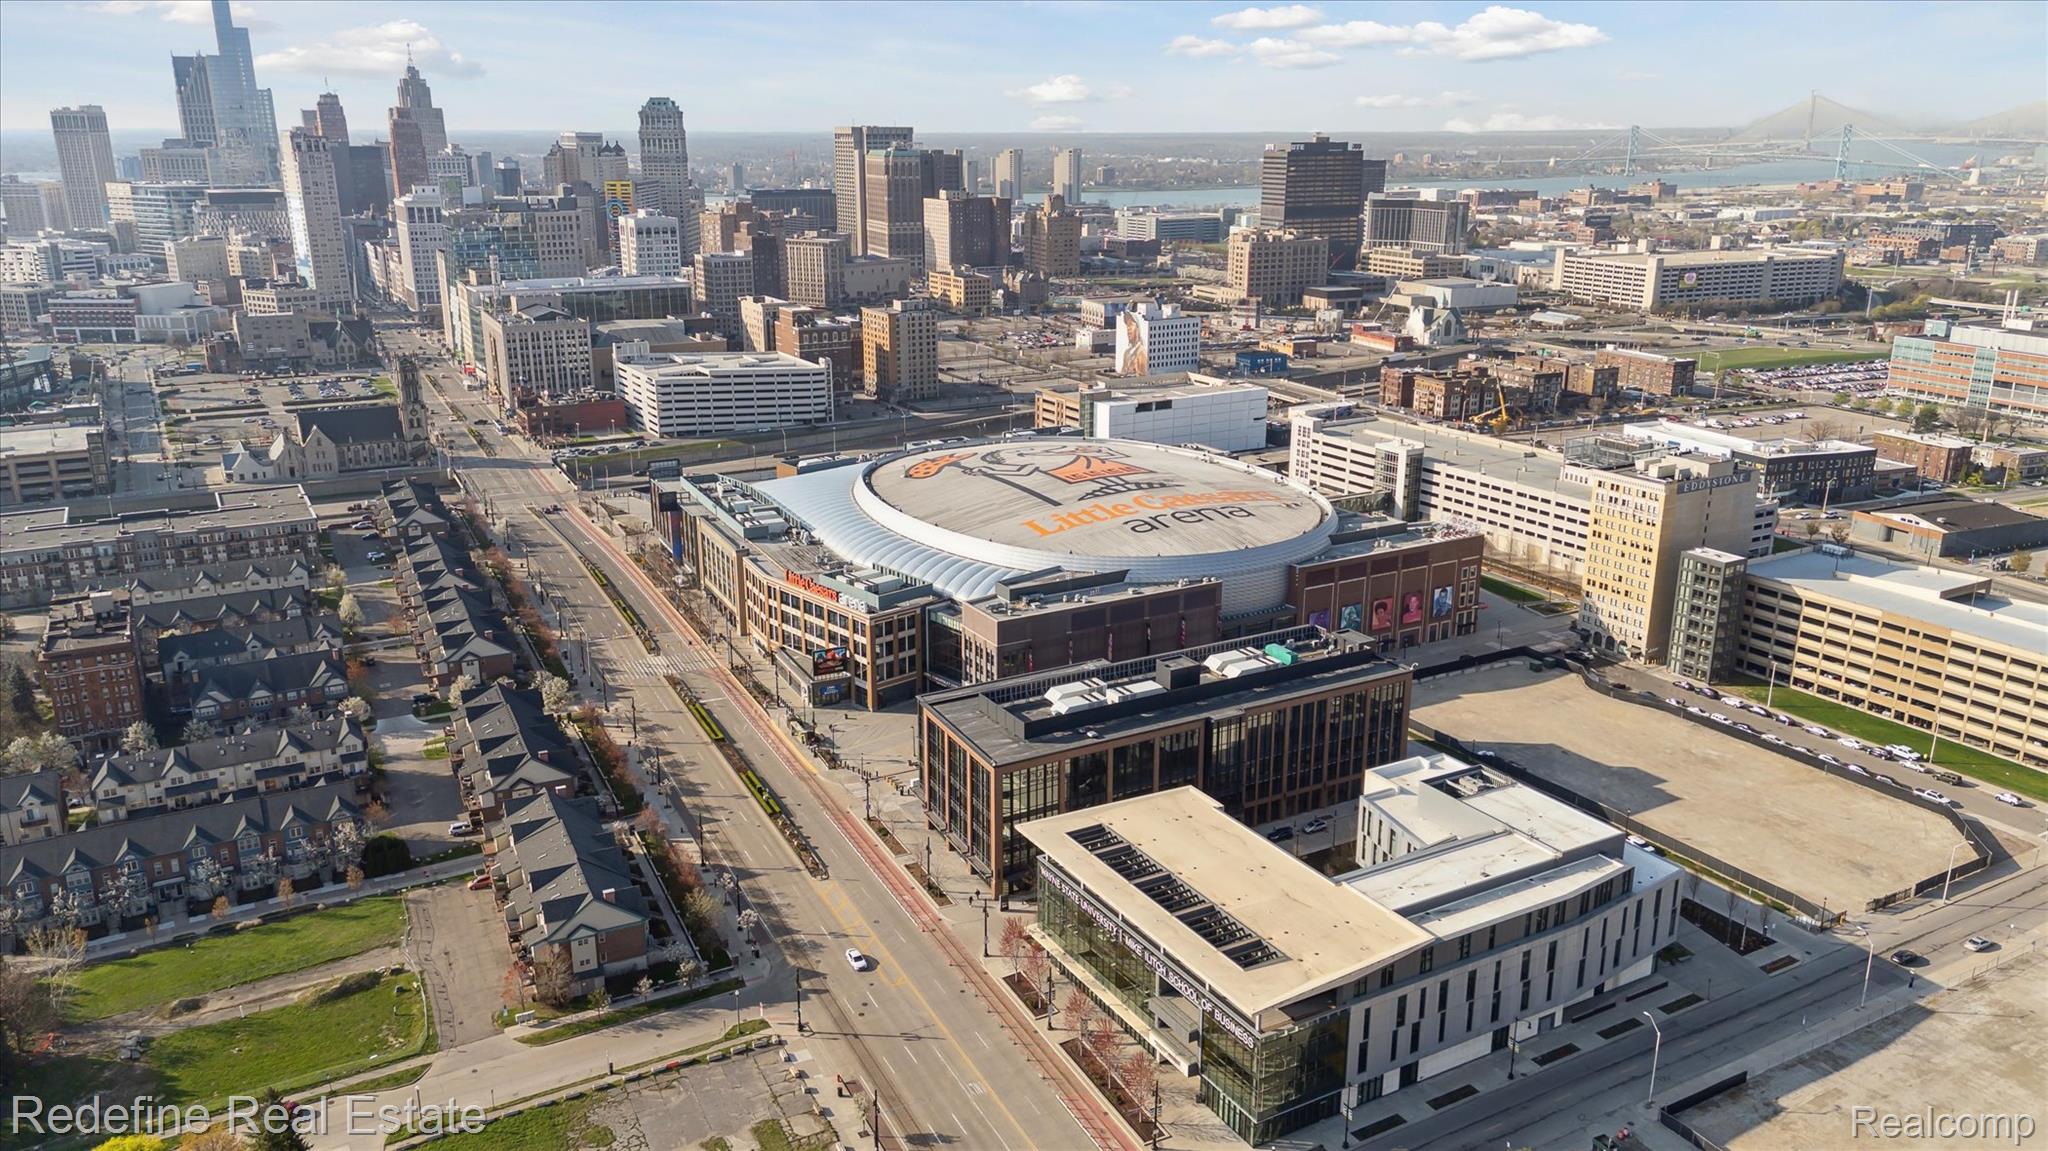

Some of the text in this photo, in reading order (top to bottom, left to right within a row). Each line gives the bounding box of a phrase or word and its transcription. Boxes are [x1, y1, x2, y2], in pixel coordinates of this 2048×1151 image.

[1683, 474, 1745, 492] EDDYSTONE
[1020, 498, 1139, 537] Little
[1123, 505, 1256, 533] arena
[1040, 865, 1061, 888] WAYNE
[1061, 884, 1080, 905] STATE
[1080, 899, 1118, 936] UNIVERSITY
[1125, 935, 1144, 957] MIKE
[1168, 972, 1199, 1004] SCHOOL
[1200, 998, 1213, 1013] OF
[1214, 1009, 1255, 1049] BUSINESS
